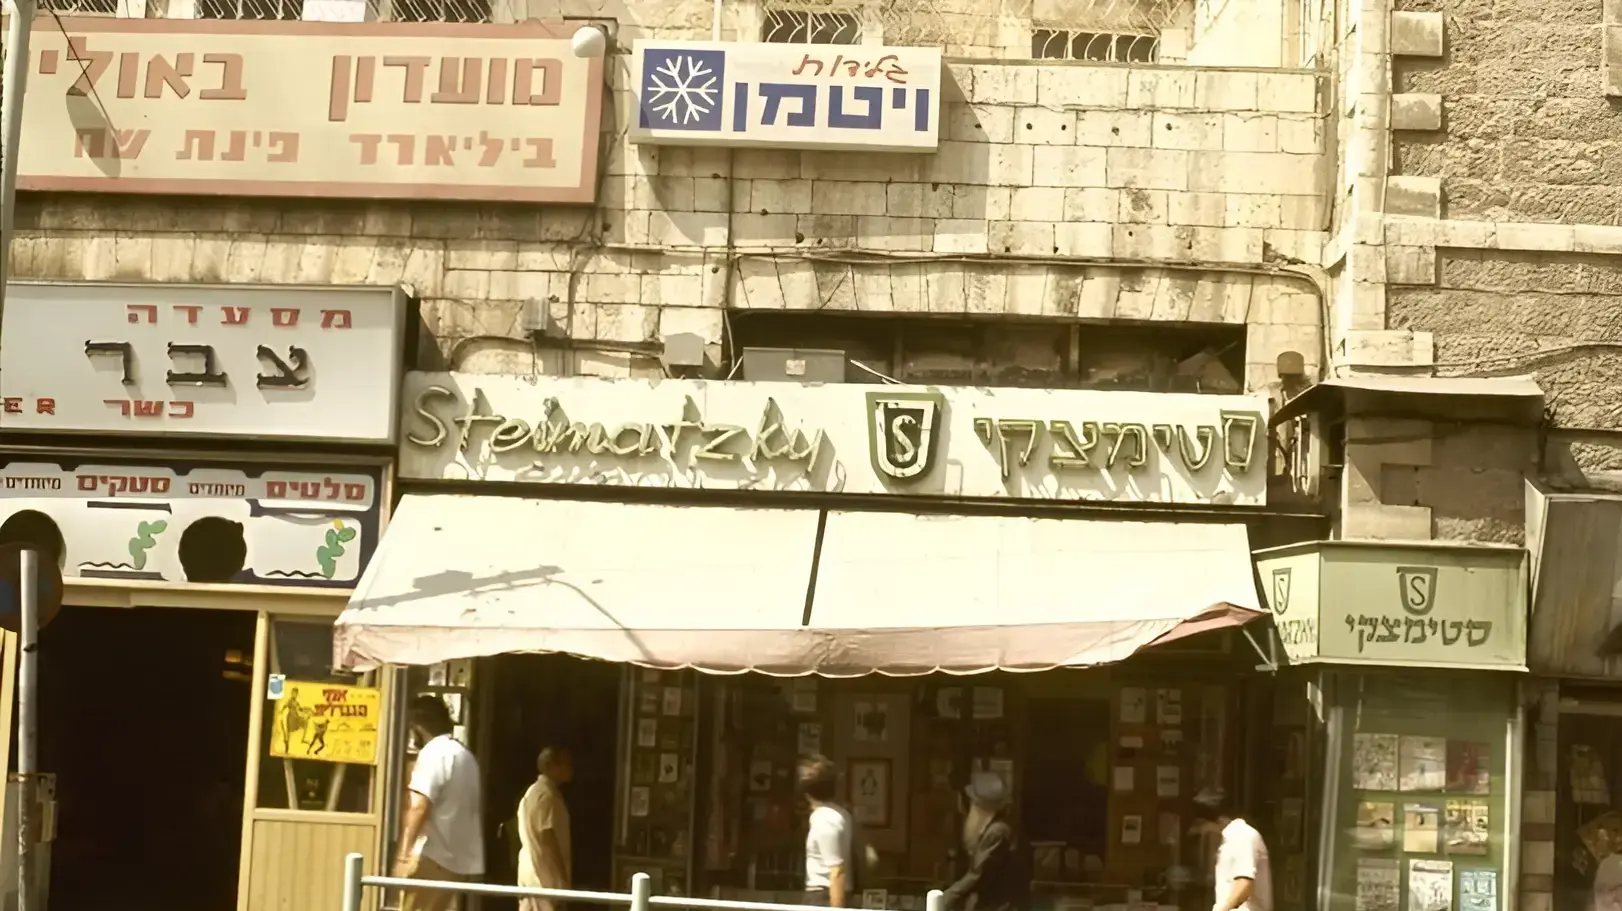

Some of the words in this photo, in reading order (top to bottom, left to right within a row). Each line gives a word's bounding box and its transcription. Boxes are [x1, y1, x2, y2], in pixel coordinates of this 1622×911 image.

[38, 36, 247, 100] באולי
[792, 53, 908, 84] גלידות
[328, 54, 563, 121] מועדון
[733, 82, 930, 132] ויטמן
[74, 127, 152, 160] שח
[176, 129, 299, 163] פינת
[350, 130, 556, 168] ביליארד
[127, 304, 352, 329] מסעדה
[85, 340, 311, 390] צבר
[103, 399, 195, 418] כשר
[407, 385, 828, 473] Steimatzky
[973, 408, 1262, 483] סטימצקי
[76, 474, 171, 497] סטקים
[266, 477, 366, 500] סלטים
[1345, 614, 1493, 653] סטימצקי
